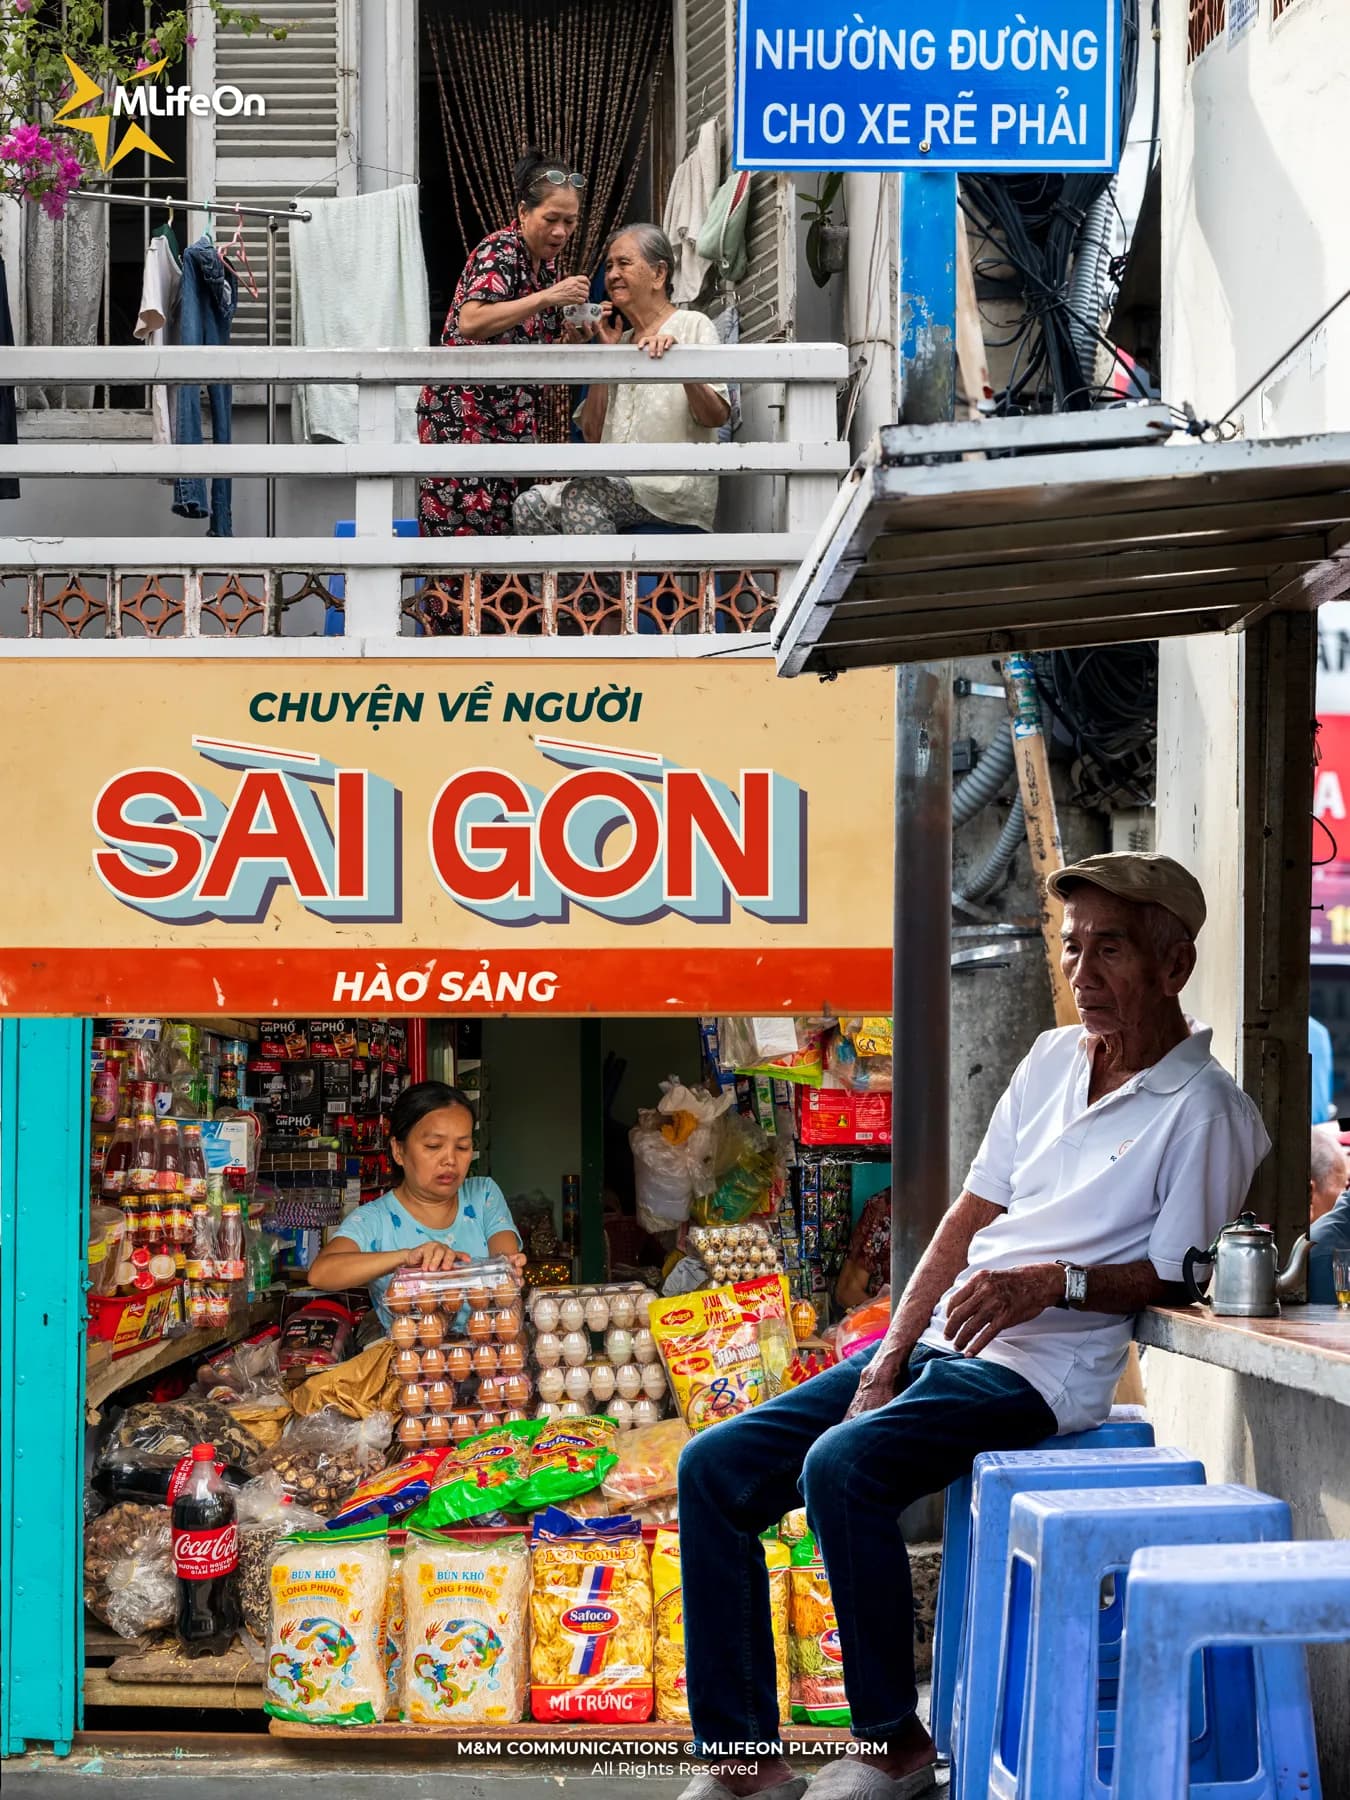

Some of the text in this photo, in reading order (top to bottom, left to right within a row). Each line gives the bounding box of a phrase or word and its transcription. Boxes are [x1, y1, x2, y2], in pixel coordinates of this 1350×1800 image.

[755, 14, 1098, 71] NHƯỜNG ĐƯỜNG
[762, 86, 1087, 145] CHO XE RẼ PHẢI
[249, 681, 643, 731] CHUYỆN VỀ NGƯỜI
[92, 735, 790, 912] SÀI GÒN
[332, 960, 560, 1004] HÀO SẢNG
[575, 1546, 637, 1563] NOODLES
[291, 1568, 311, 1580] BÚN
[436, 1569, 458, 1581] BÚN
[281, 1583, 308, 1598] LONG
[427, 1585, 455, 1598] LONG
[569, 1610, 613, 1622] Safoco
